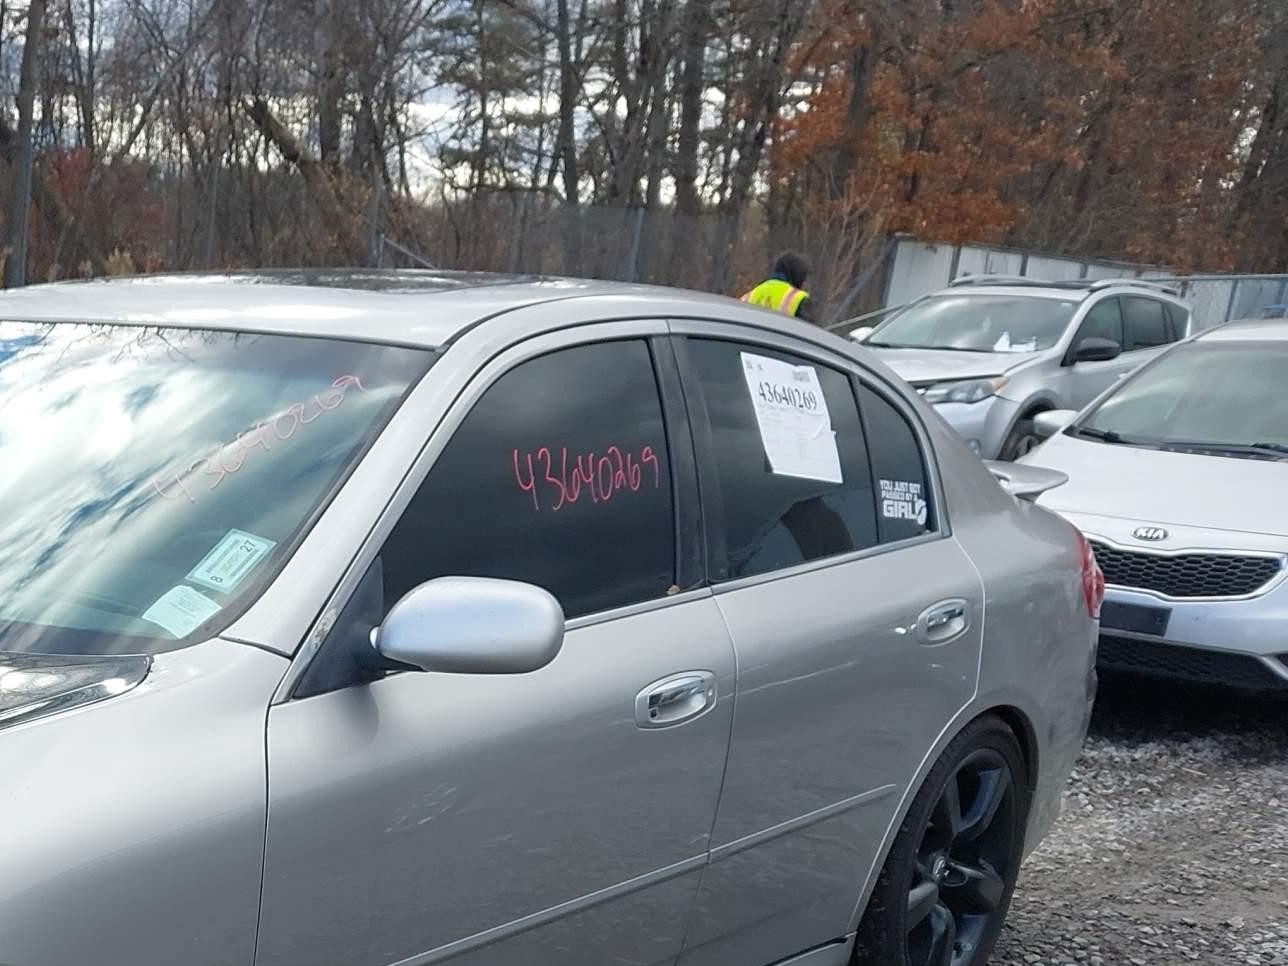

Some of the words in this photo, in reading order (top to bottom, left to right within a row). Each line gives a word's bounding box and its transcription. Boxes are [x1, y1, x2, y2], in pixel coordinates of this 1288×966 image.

[758, 381, 818, 411] 43640269
[513, 446, 659, 511] 43640269
[880, 479, 893, 491] YOU
[883, 500, 918, 519] GIRL
[1136, 528, 1165, 540] KIA
[240, 540, 255, 553] 27
